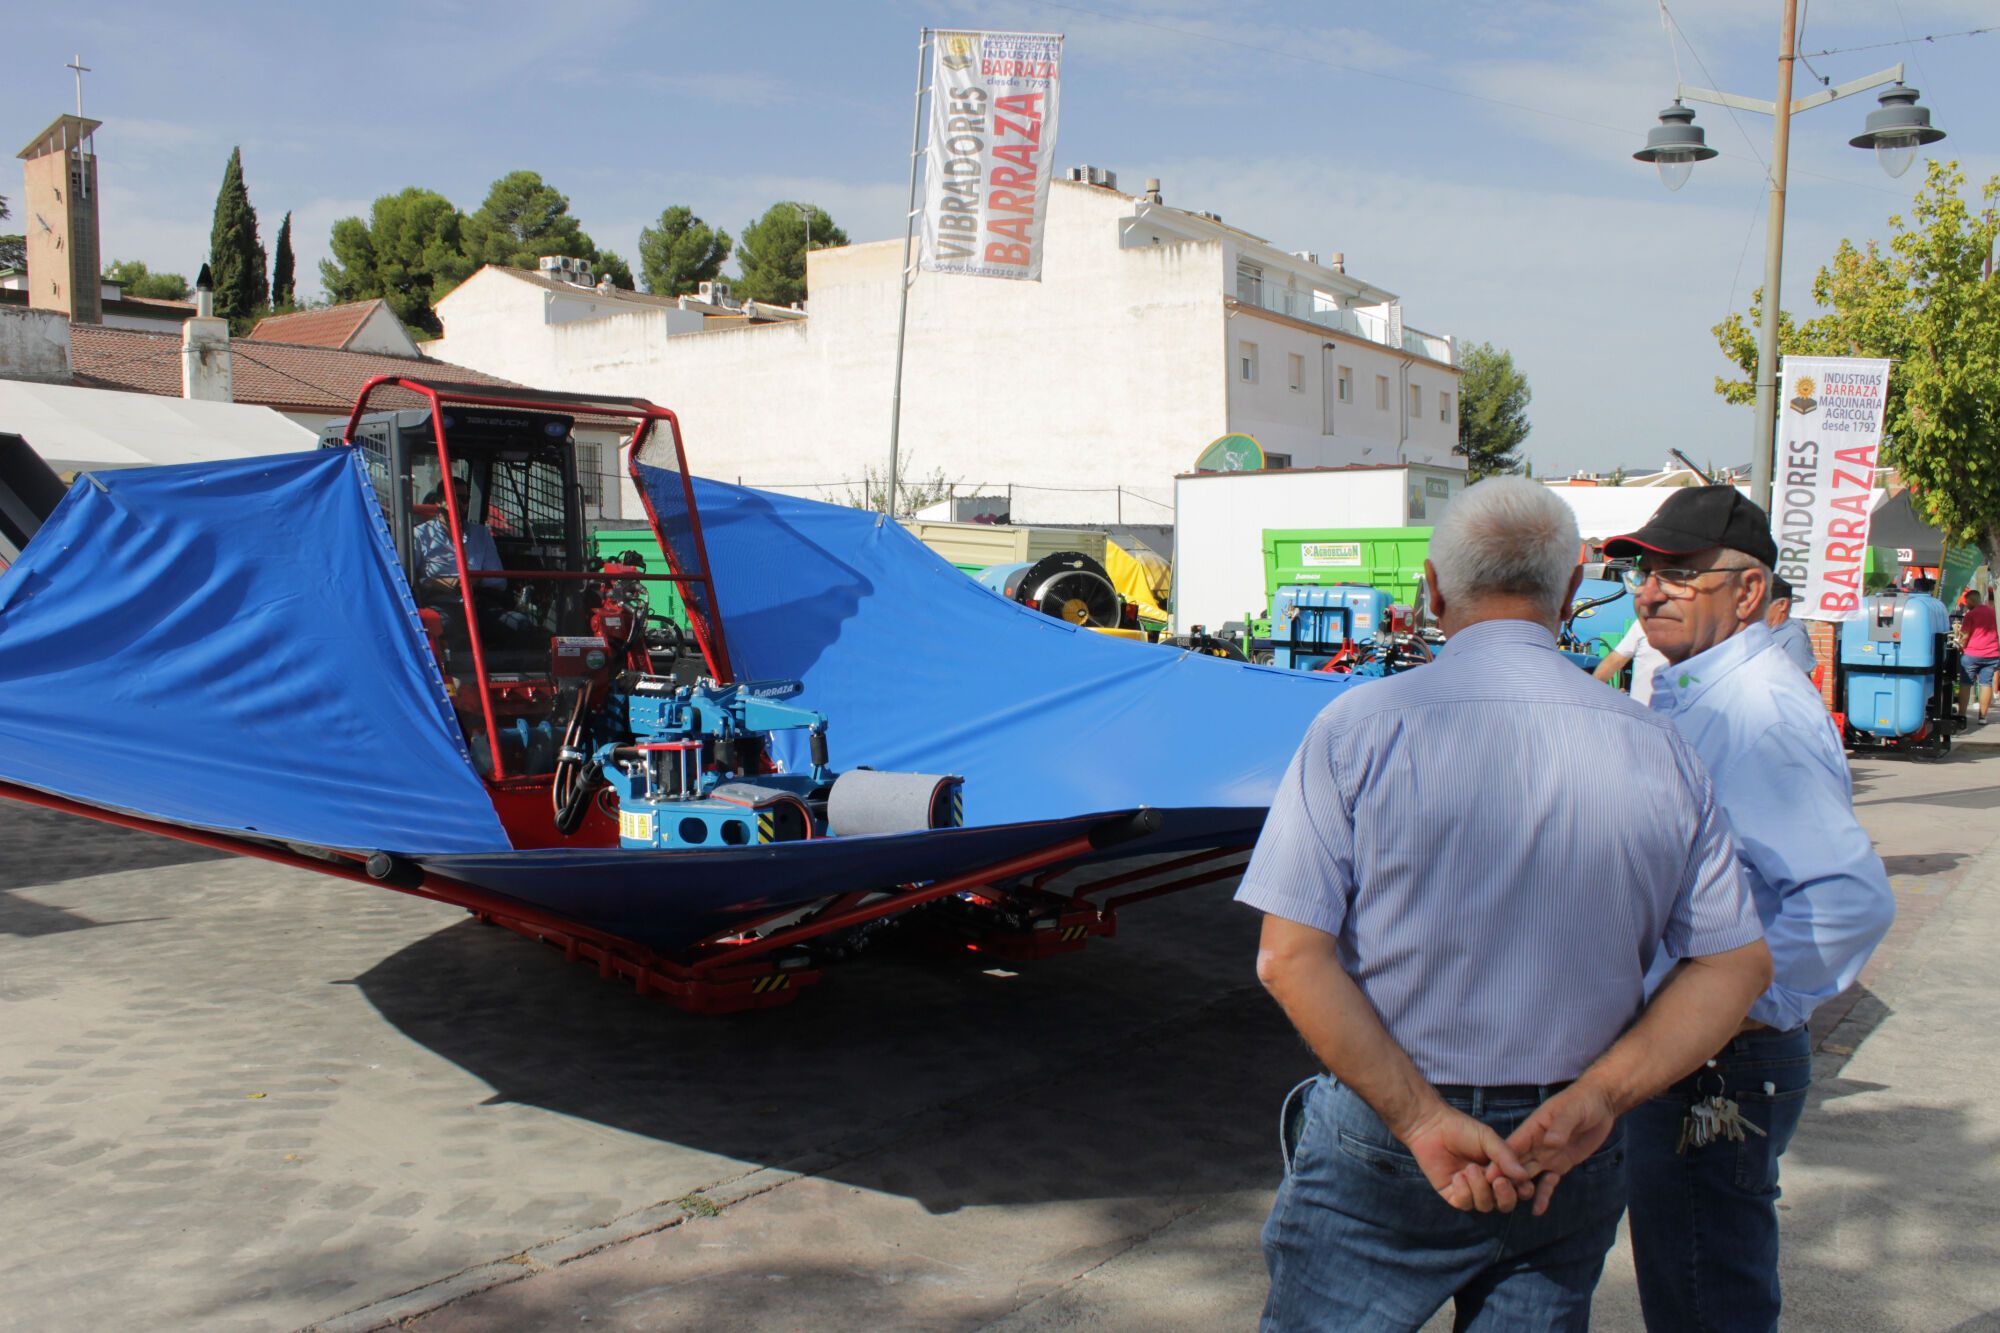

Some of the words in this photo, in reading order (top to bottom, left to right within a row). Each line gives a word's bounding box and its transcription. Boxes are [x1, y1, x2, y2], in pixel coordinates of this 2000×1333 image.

[982, 49, 1058, 61] INDUSTRIAS
[981, 59, 1057, 79] BARRAZA
[986, 77, 1020, 87] desde
[1025, 79, 1050, 89] 1792
[935, 86, 988, 261] VIBRADORES
[984, 92, 1044, 266] BARRAZA
[934, 262, 1029, 278] www.barraza.es
[1823, 372, 1882, 386] INDUSTRIAS
[1825, 383, 1878, 398] BARRAZA
[1819, 395, 1882, 409] MAQUINARIA
[1825, 408, 1874, 421] AGRICOLA
[1822, 419, 1850, 432] desde
[1853, 421, 1876, 433] 1792
[1820, 444, 1877, 612] BARRAZA
[753, 683, 794, 697] BARRAZA
